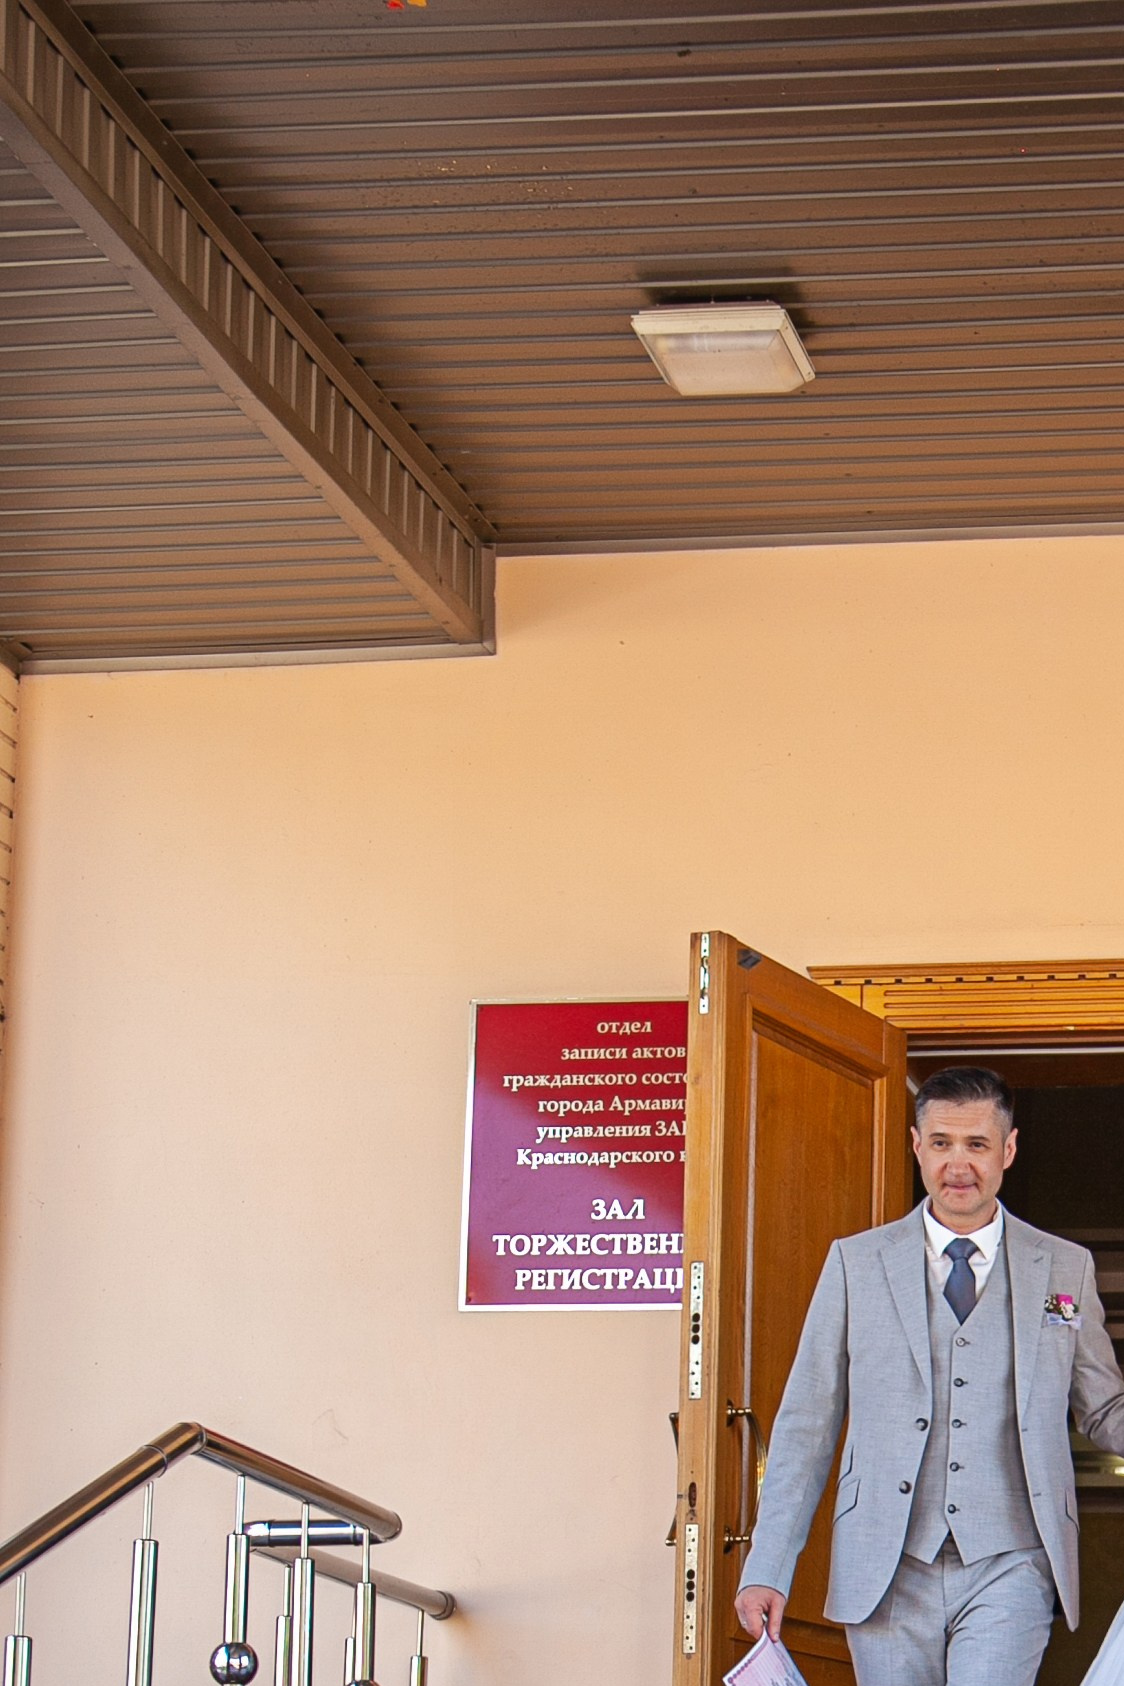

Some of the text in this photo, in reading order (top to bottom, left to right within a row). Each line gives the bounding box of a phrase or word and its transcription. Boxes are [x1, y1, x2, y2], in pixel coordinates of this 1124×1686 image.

[597, 1021, 652, 1035] отдел
[561, 1046, 686, 1060] записи актов
[503, 1073, 637, 1092] гражданского
[538, 1095, 687, 1117] города Армави
[535, 1124, 651, 1143] управления
[516, 1148, 674, 1169] Краснодарского
[590, 1198, 645, 1220] ЗАЛ
[492, 1233, 684, 1256] ТОРЖЕСТВЕН
